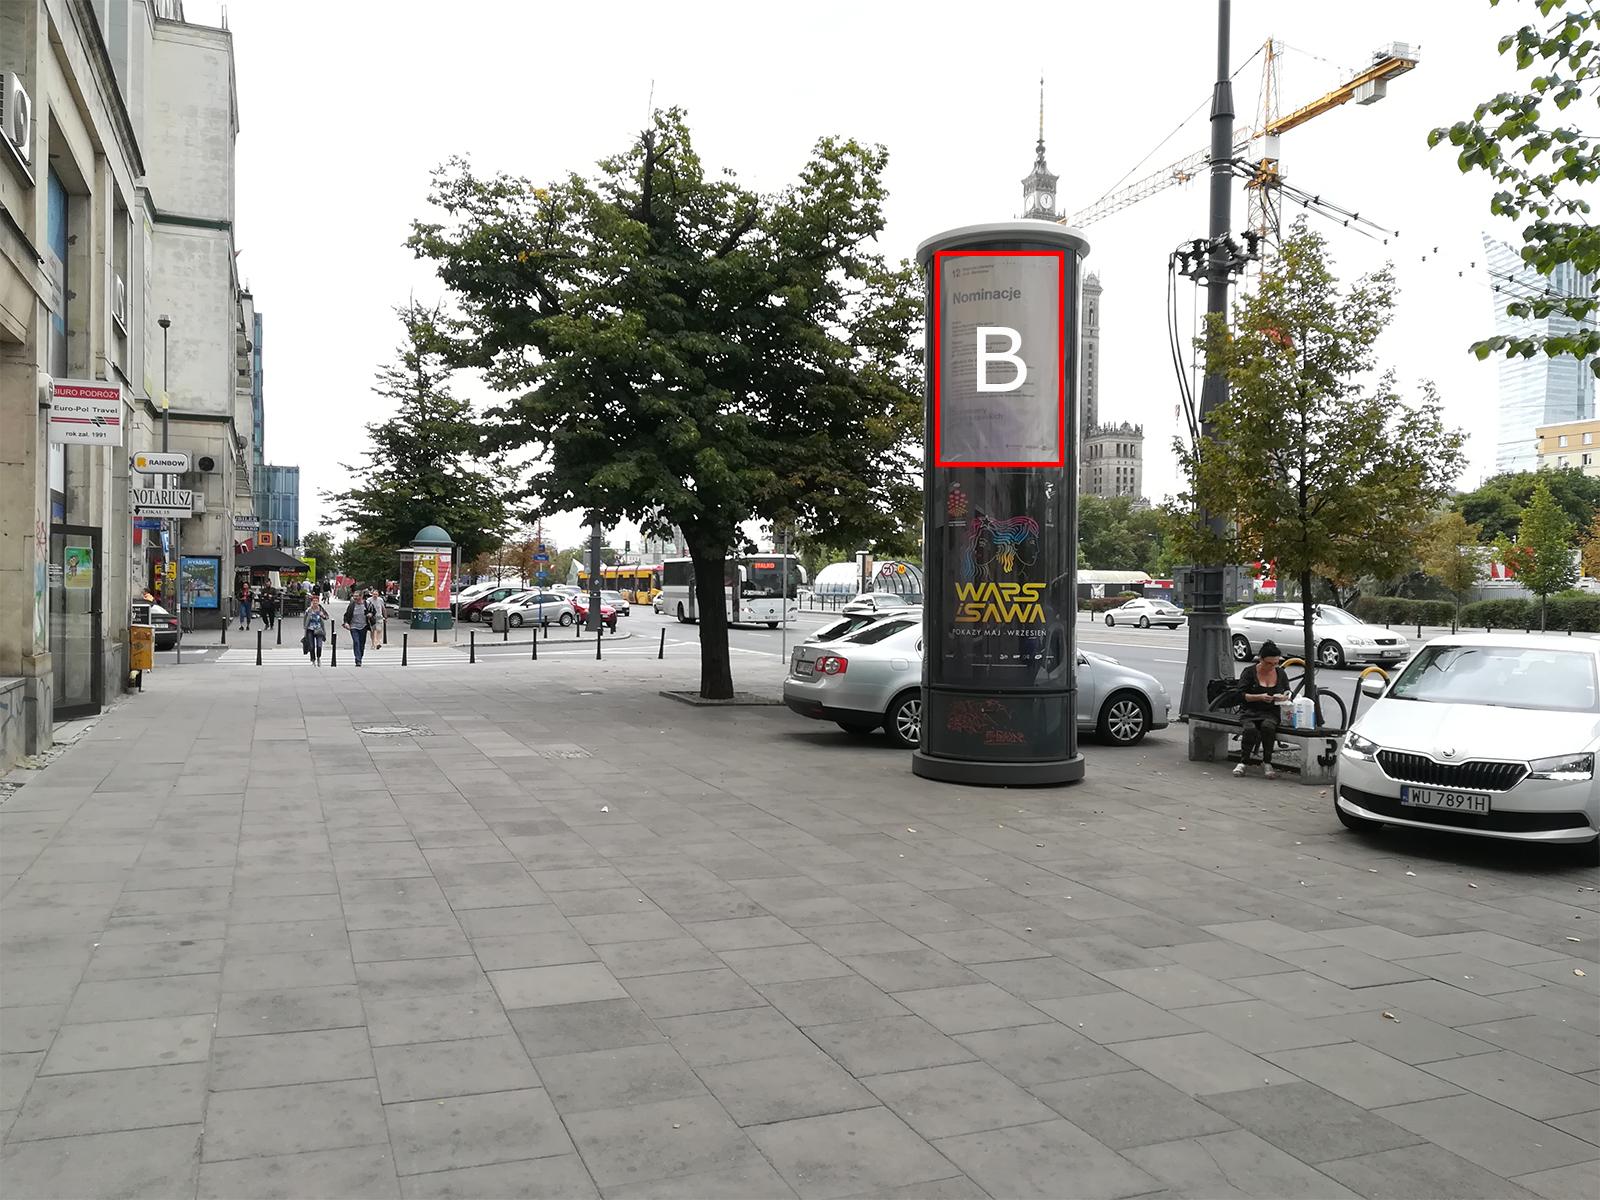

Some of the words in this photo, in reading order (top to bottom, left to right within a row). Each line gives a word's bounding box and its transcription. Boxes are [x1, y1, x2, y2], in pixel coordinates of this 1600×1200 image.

[953, 287, 1021, 305] Nominacje
[53, 388, 78, 397] BIURO
[54, 404, 89, 413] Euro-Pol
[92, 406, 118, 414] Travel
[148, 459, 185, 467] RAINBOW
[133, 488, 192, 506] NOTARIUSZ
[955, 582, 1047, 602] WARS
[952, 628, 981, 637] POKAZY
[983, 629, 1001, 637] MAJ
[1411, 789, 1431, 804] WU
[1436, 792, 1486, 811] 7891H
